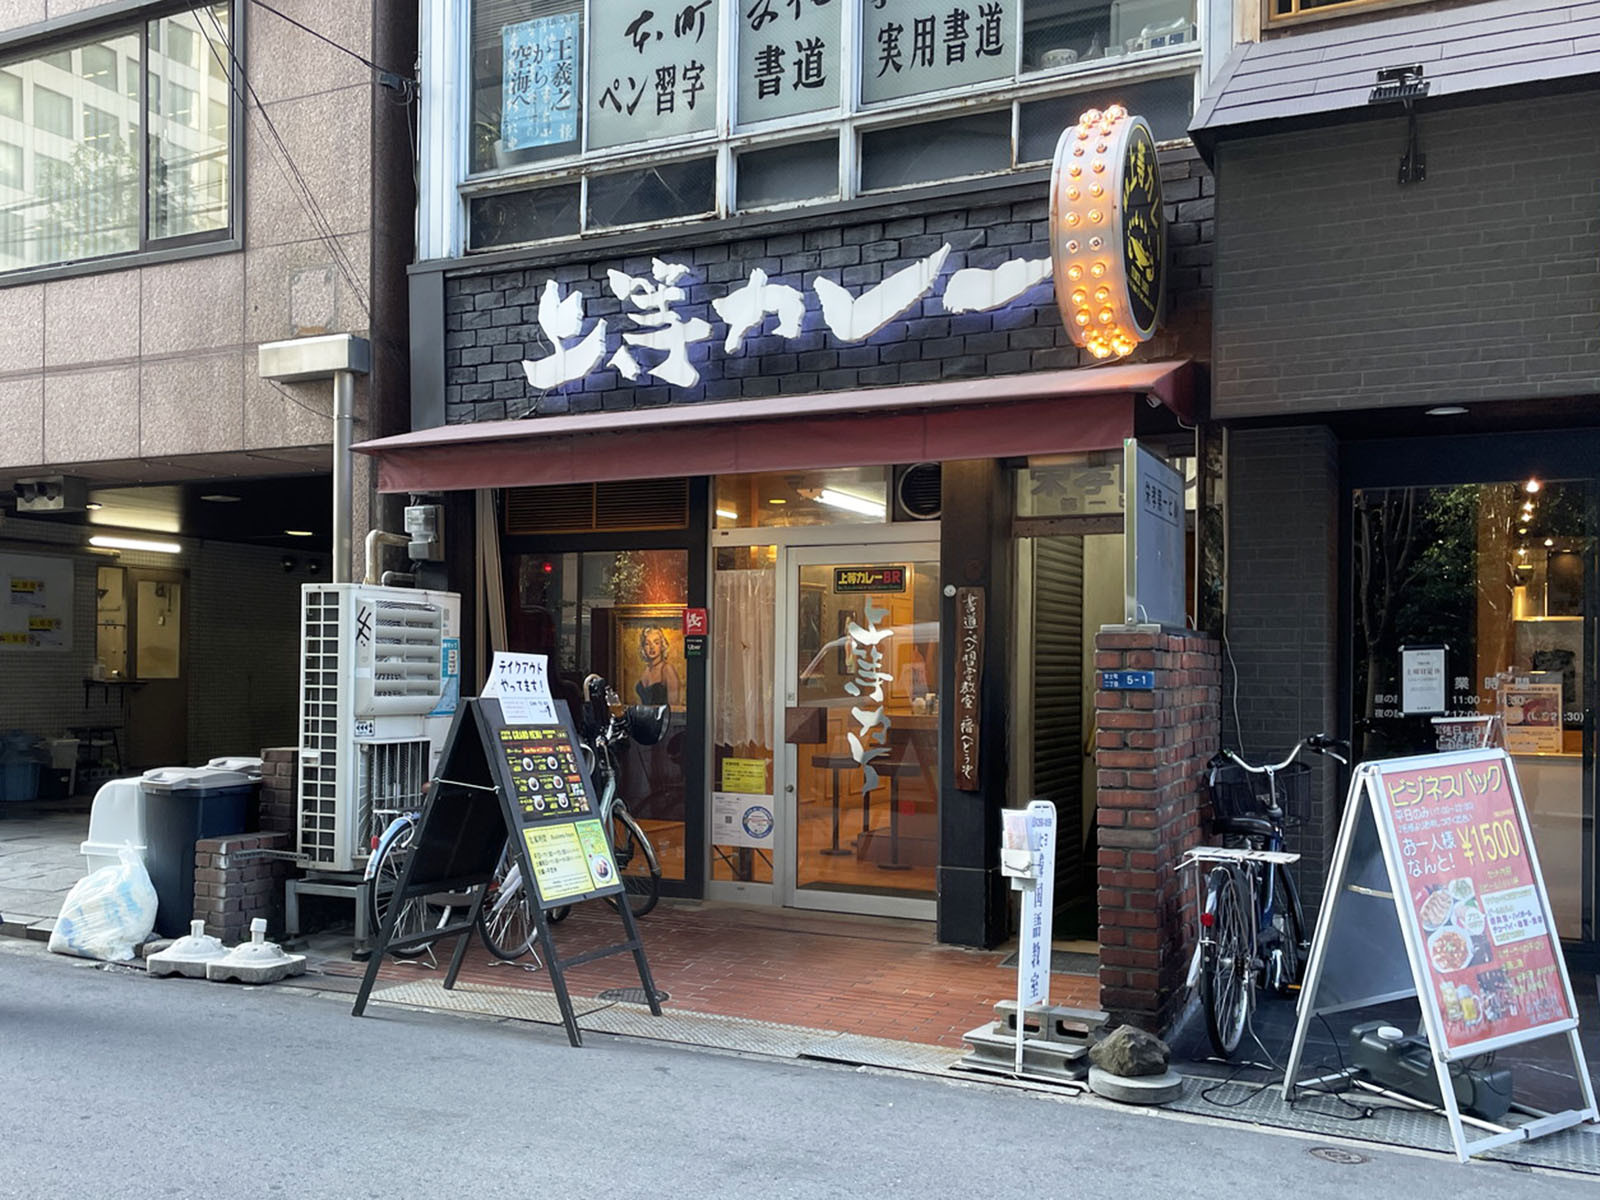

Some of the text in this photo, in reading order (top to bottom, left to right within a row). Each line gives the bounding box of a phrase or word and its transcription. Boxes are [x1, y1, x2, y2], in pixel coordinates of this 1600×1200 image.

[876, 2, 1005, 78] 実用書道
[599, 60, 706, 116] ペン習字
[754, 36, 829, 100] 書道
[522, 242, 1054, 389] 上等カレー
[499, 660, 543, 675] テイクアウト
[1127, 674, 1147, 685] 5-1
[1453, 695, 1481, 705] 11:00
[1387, 765, 1502, 807] ビジネスパック
[1402, 829, 1457, 857] お一人様
[1455, 819, 1520, 865] ¥1500
